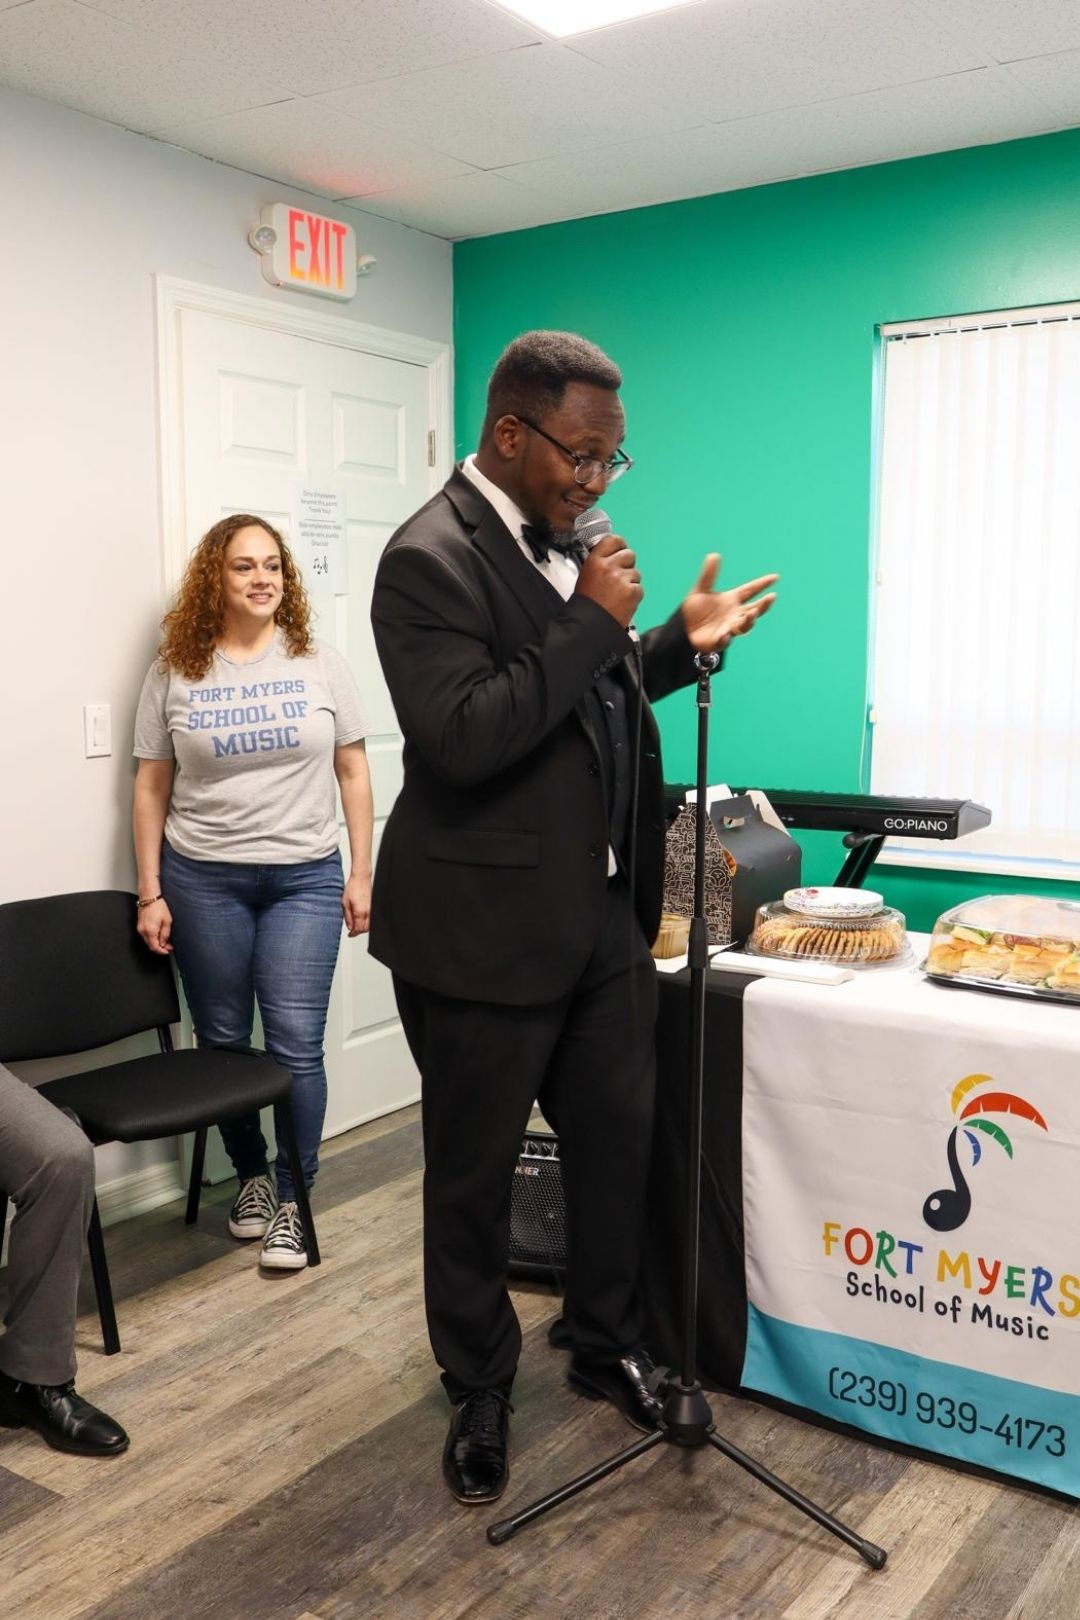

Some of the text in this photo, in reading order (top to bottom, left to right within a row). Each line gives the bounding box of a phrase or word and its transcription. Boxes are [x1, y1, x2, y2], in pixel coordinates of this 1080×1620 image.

[288, 208, 348, 291] EXIT
[187, 700, 309, 730] SCHOOL OF
[188, 680, 305, 702] FORT MYERS
[211, 726, 300, 758] MUSIC
[883, 818, 949, 832] GO:PIANO
[822, 1222, 1080, 1319] FORT MYERS
[846, 1271, 1050, 1341] School of Music
[828, 1366, 1067, 1458] (239) 939-4173
